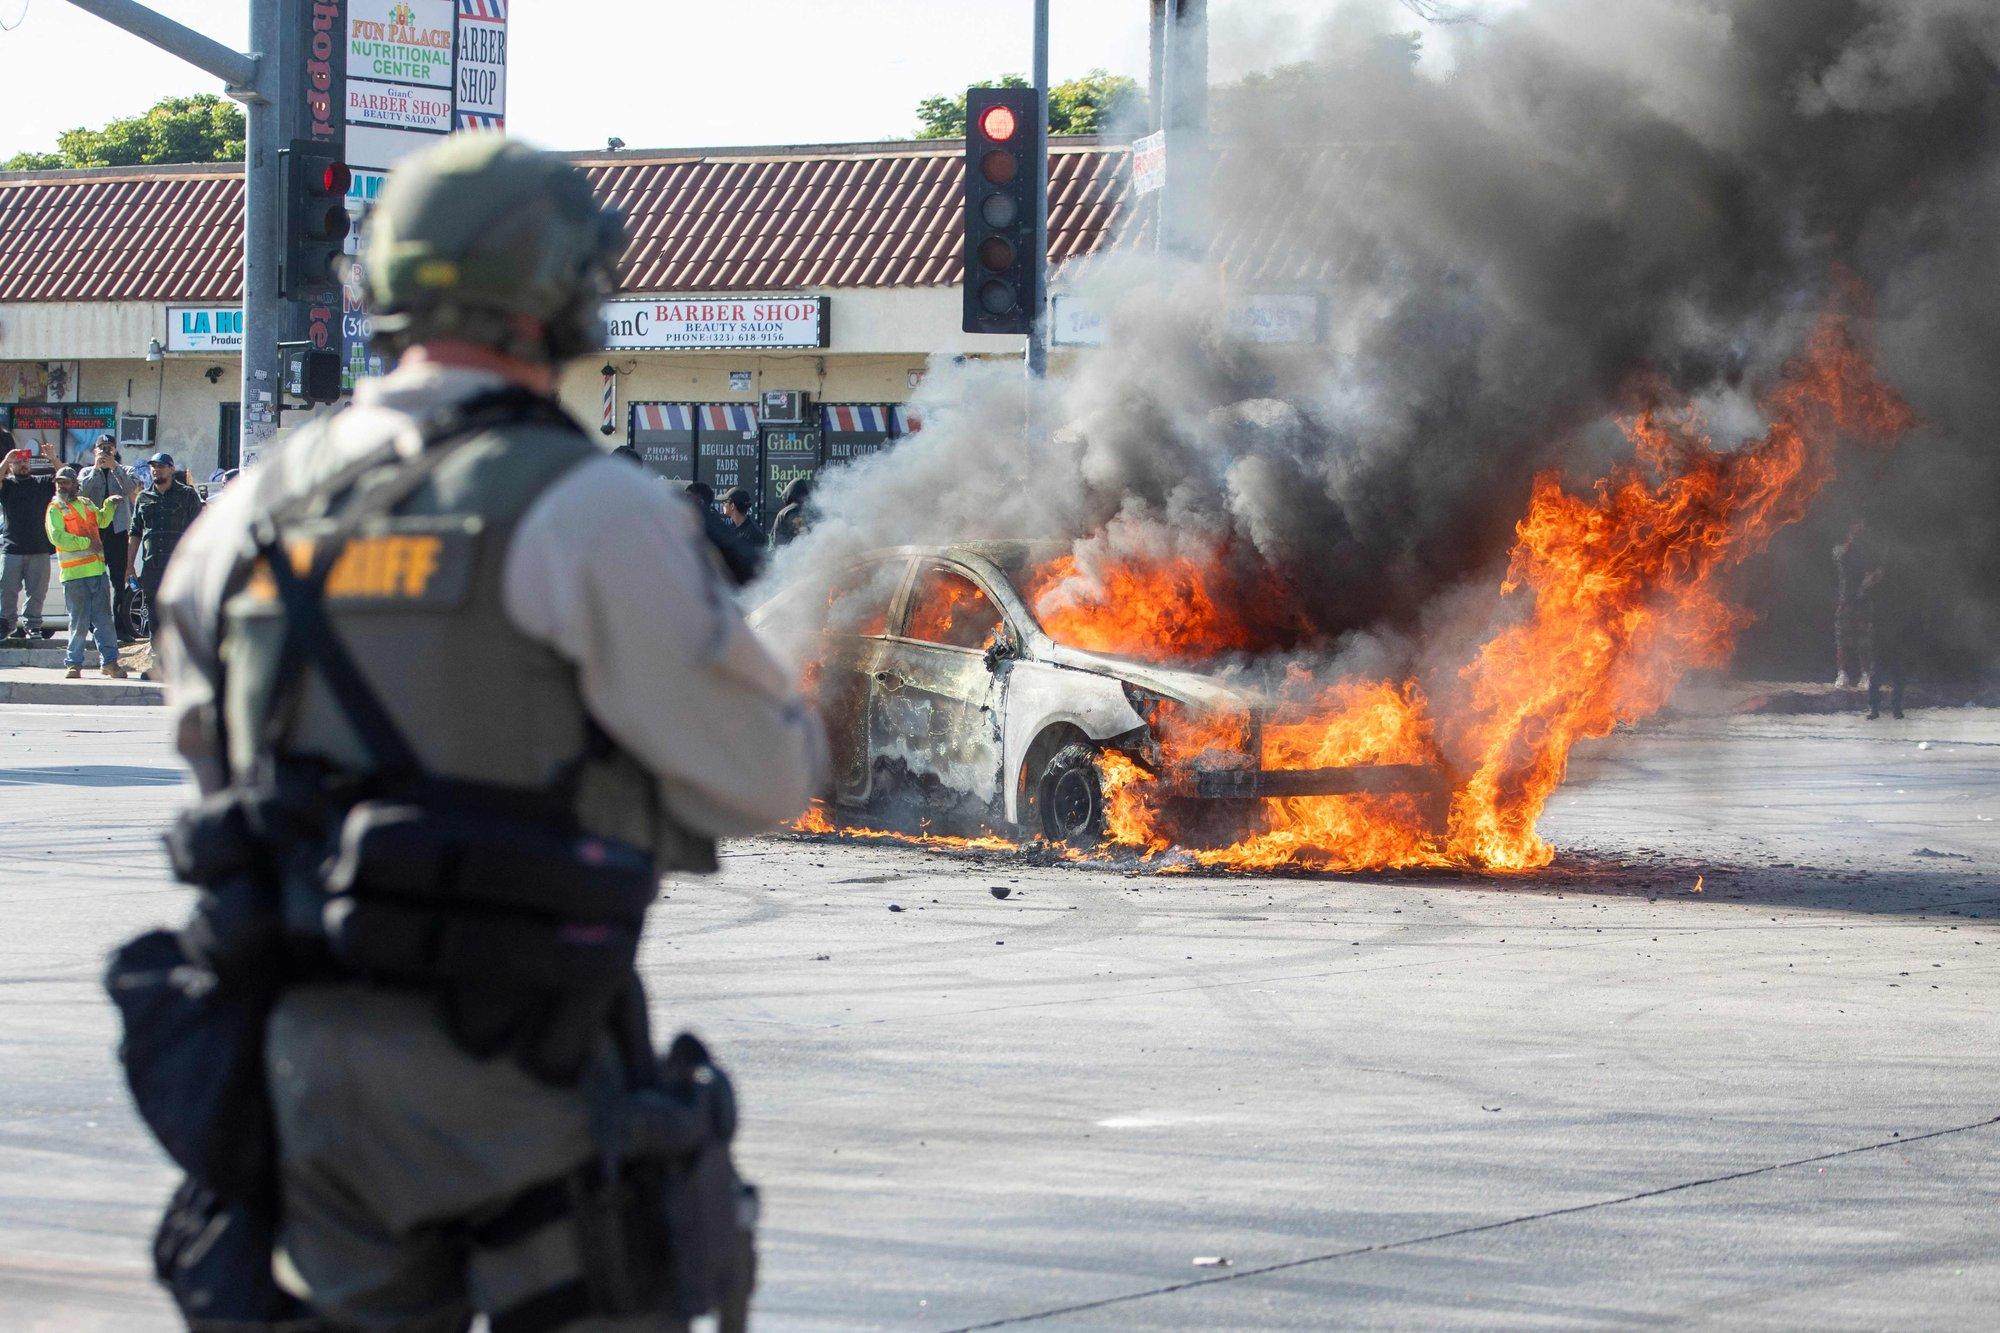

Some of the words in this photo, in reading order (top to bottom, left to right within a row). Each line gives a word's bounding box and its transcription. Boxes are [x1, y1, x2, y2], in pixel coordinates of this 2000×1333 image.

[352, 19, 385, 40] FUN
[389, 25, 450, 49] PALACE
[351, 40, 450, 66] NUTRITIONAL
[460, 26, 505, 66] ARBER
[372, 60, 431, 79] CENTER
[387, 88, 414, 99] GianC
[460, 66, 497, 105] SHOP
[350, 93, 408, 113] BARBER
[413, 100, 451, 117] SHOP
[363, 110, 402, 121] BEAUTY
[405, 115, 437, 125] SALON
[183, 312, 211, 334] LA
[216, 311, 243, 334] HO
[342, 315, 373, 339] (310
[602, 311, 649, 337] anC
[655, 305, 746, 322] BARBER
[753, 304, 816, 322] SHOP
[686, 323, 737, 332] BEAUTY
[741, 322, 784, 332] SALON
[211, 335, 243, 345] Produc
[738, 332, 784, 342] 618-9156
[701, 444, 734, 456] REGULAR
[736, 444, 755, 456] CUTS
[767, 433, 815, 450] GianC
[832, 444, 850, 456] HAIR
[644, 454, 688, 462] 23)618-9156
[716, 459, 739, 470] FADES
[715, 474, 739, 485] TAPER
[770, 464, 813, 481] Barber
